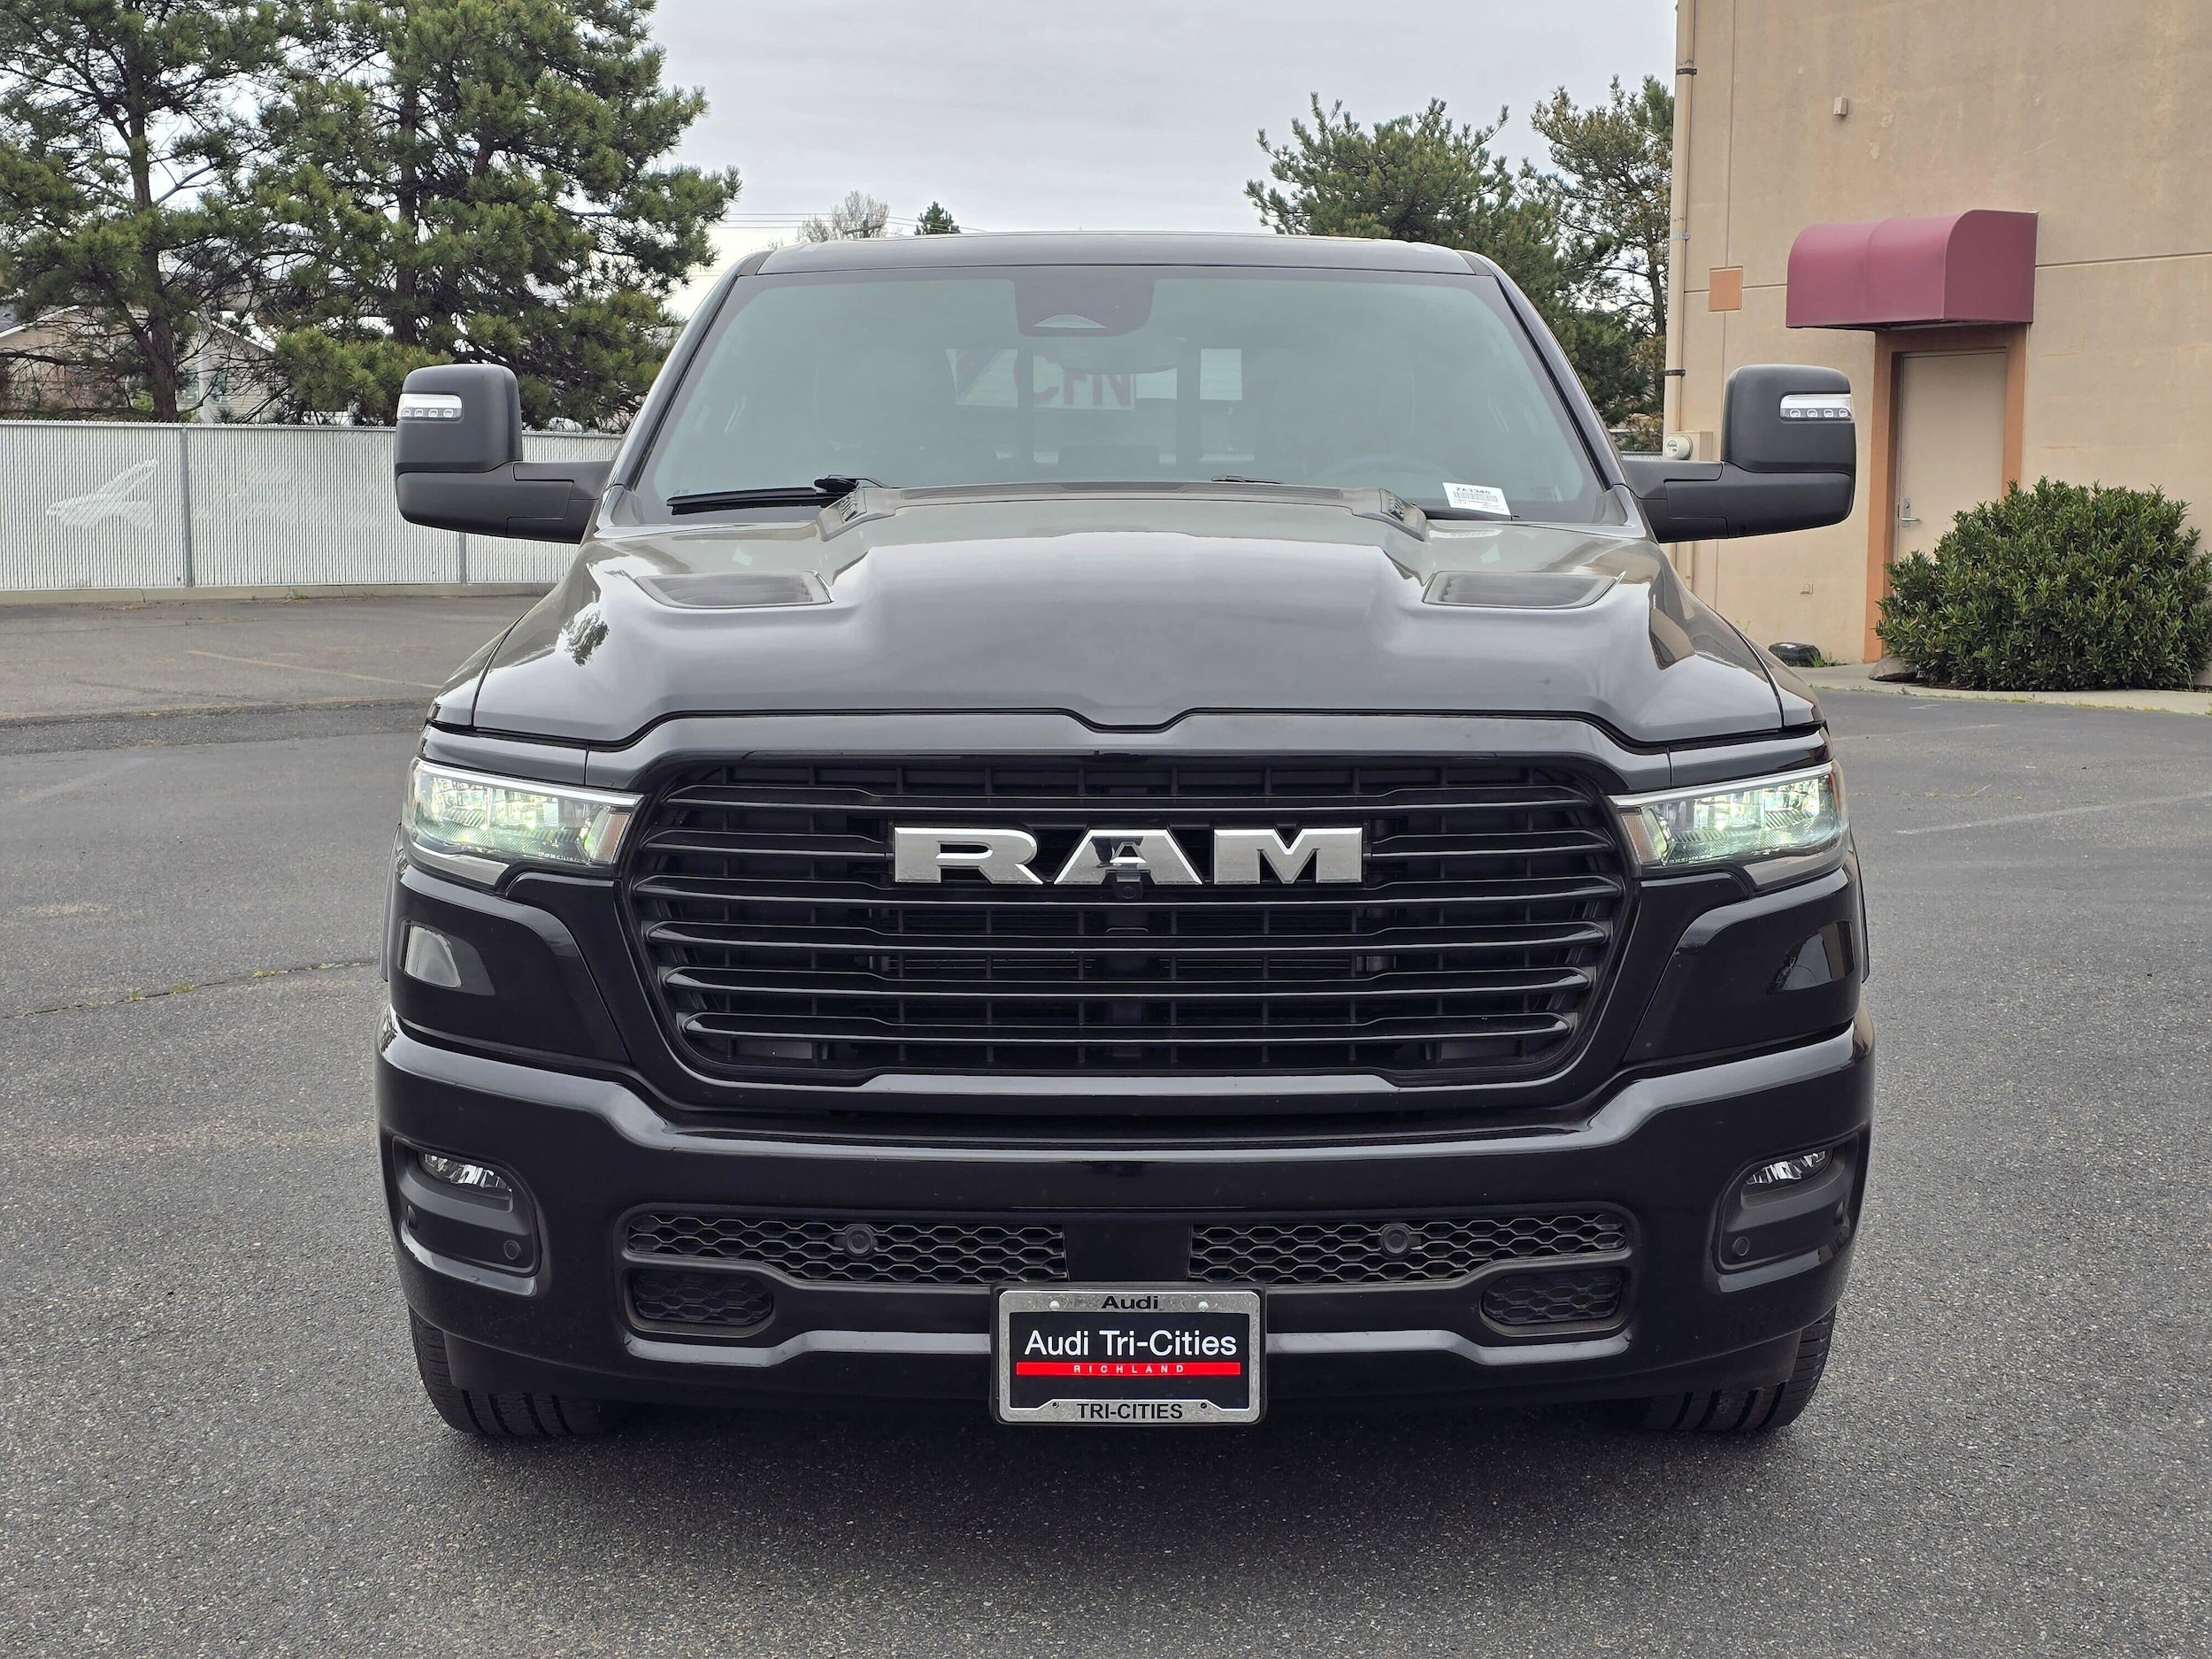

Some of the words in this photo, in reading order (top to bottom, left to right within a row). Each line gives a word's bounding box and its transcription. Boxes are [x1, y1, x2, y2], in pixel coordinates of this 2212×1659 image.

[894, 827, 1363, 885] RAM
[1101, 1295, 1159, 1310] Audi
[1025, 1330, 1089, 1356] Audi
[1099, 1330, 1237, 1356] Tri-Cities
[1073, 1364, 1185, 1373] RICHLAND
[1077, 1403, 1183, 1419] TRI-CITIES
